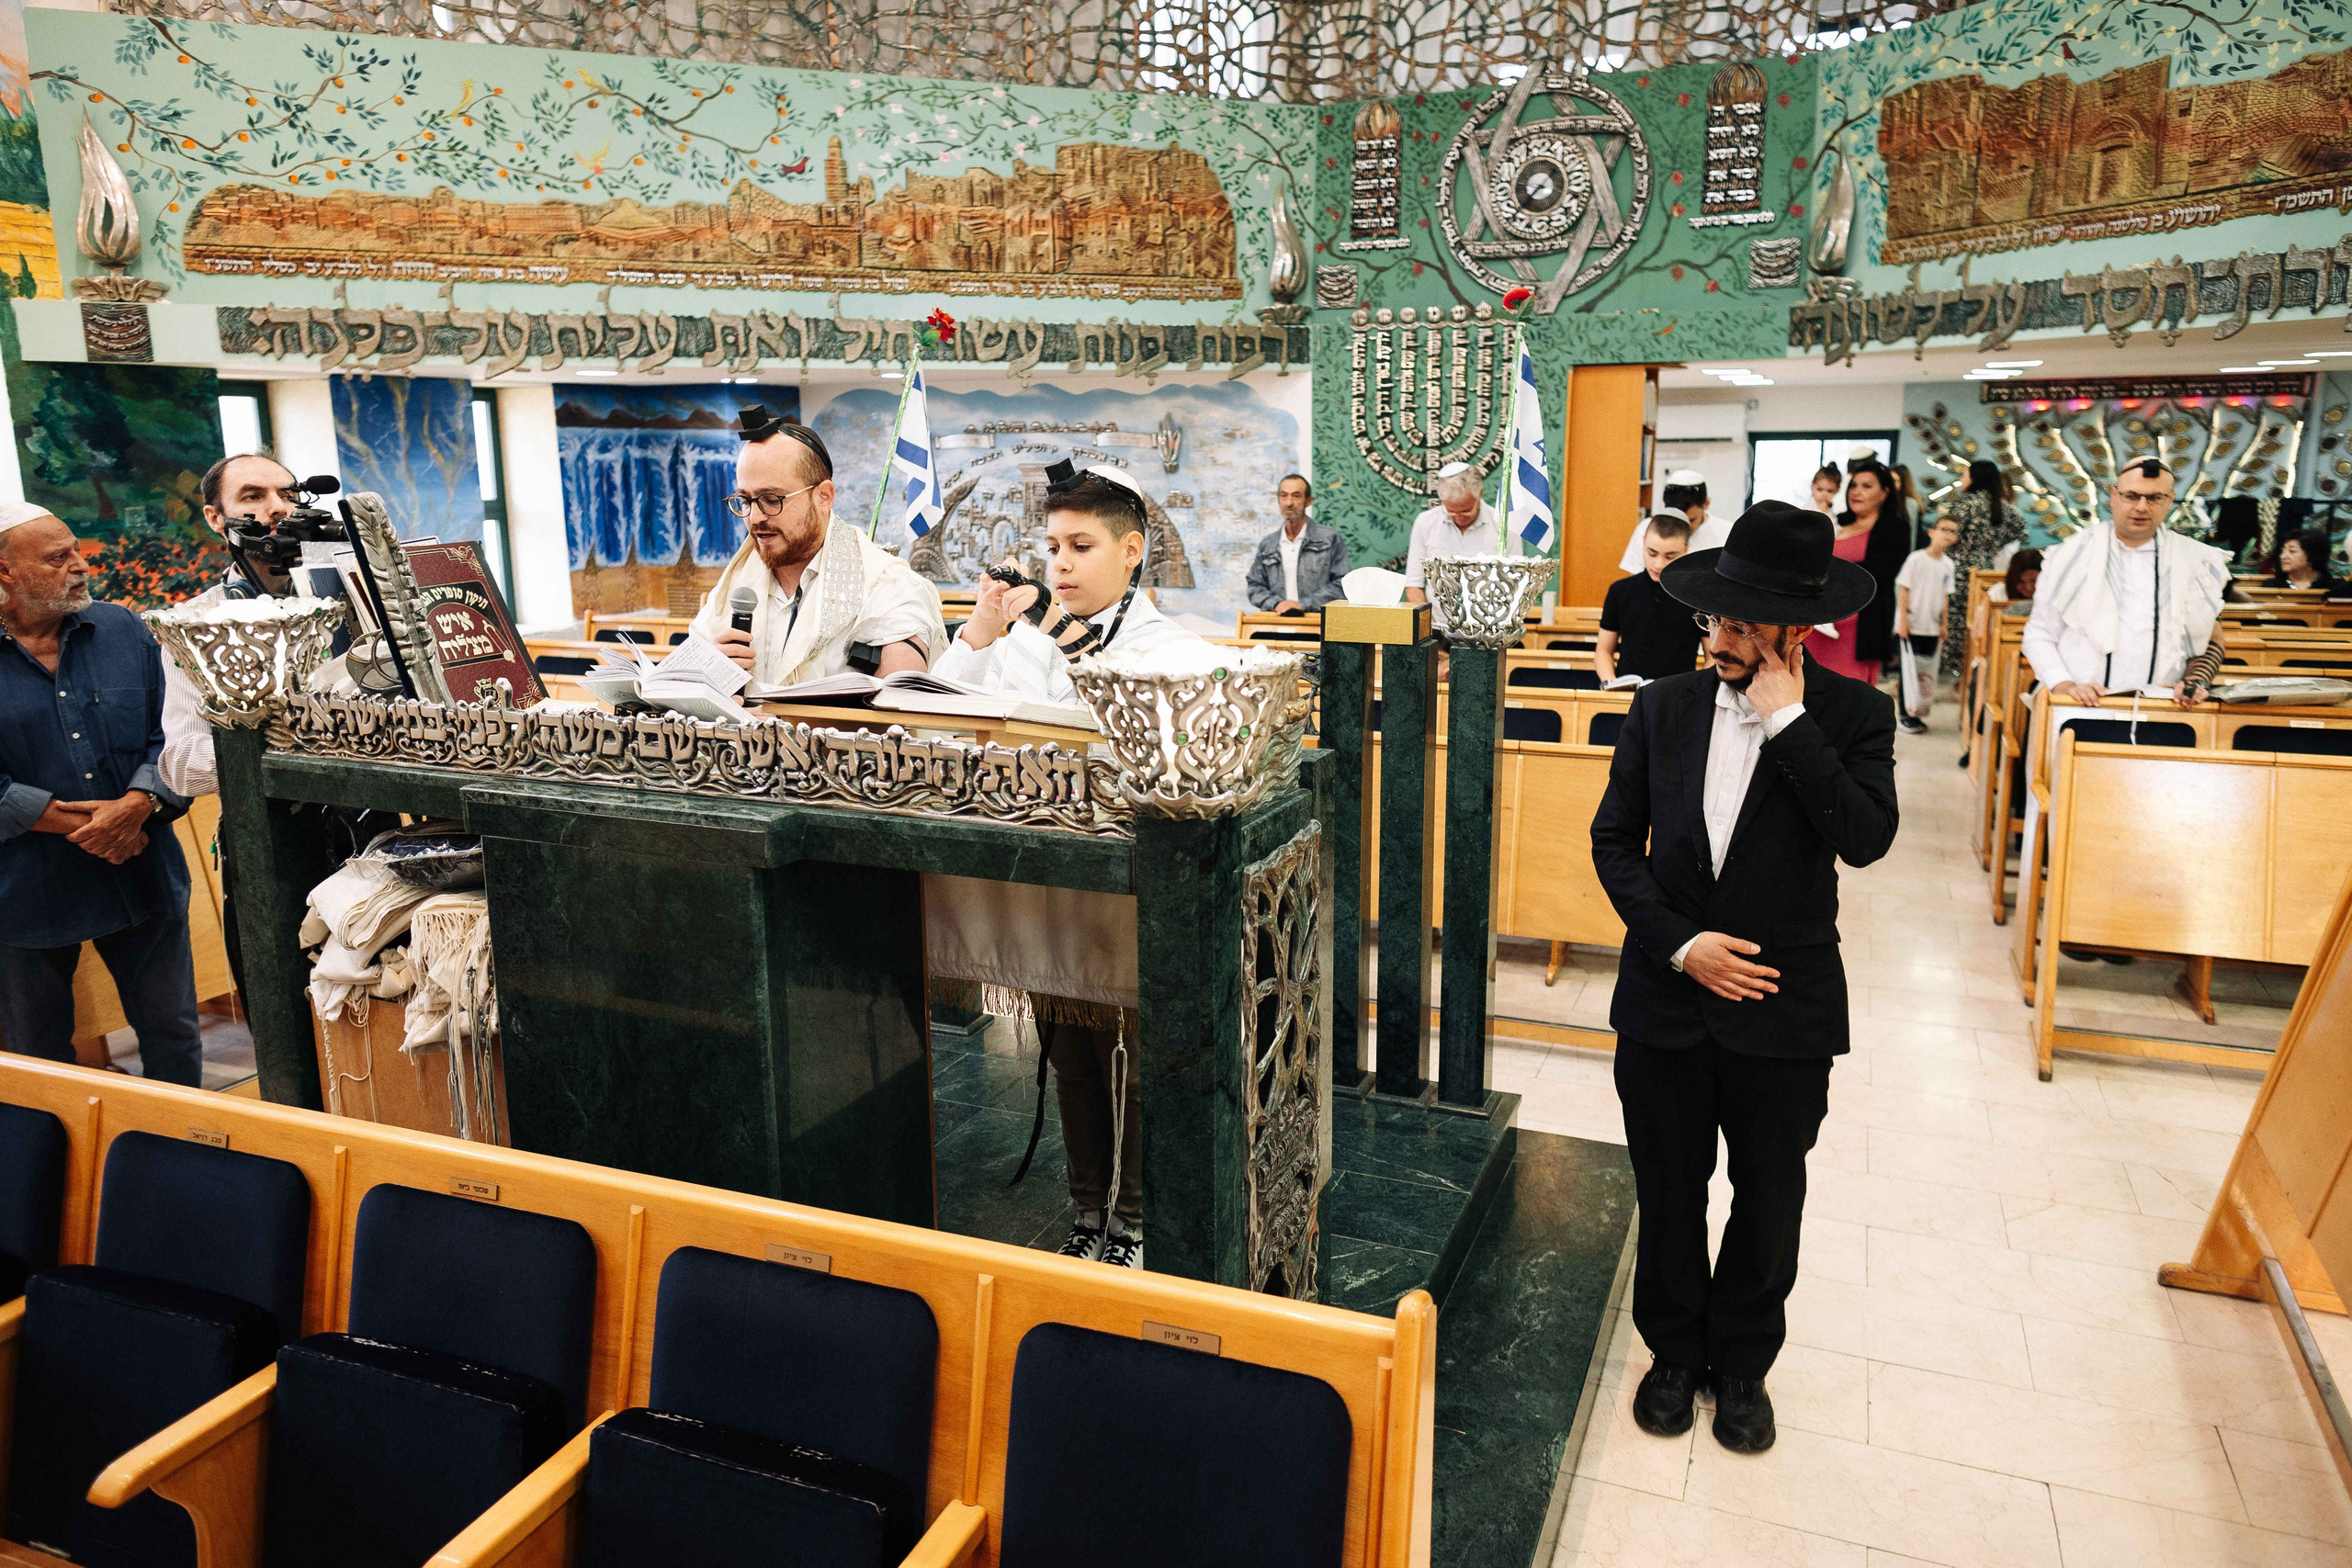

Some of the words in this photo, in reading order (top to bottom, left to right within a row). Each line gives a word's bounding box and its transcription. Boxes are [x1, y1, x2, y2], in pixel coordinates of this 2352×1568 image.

[542, 282, 676, 375] עלית
[701, 307, 813, 369] ואת
[829, 290, 916, 364] חיל
[953, 316, 1046, 378] עשו
[1069, 316, 1167, 378] בנות
[1187, 317, 1288, 378] רבות
[430, 586, 463, 601] סופרים
[435, 611, 475, 635] איש
[465, 590, 489, 610] תיקון
[438, 633, 494, 661] מצליח
[289, 668, 390, 736] ישראל
[393, 698, 447, 741] בני
[457, 677, 528, 747] לפני
[538, 706, 623, 757] משה
[635, 709, 700, 764] שם
[697, 716, 812, 774] אשר
[825, 724, 968, 799] התורה
[981, 741, 1090, 802] וזאת
[1163, 1331, 1181, 1341] ציון
